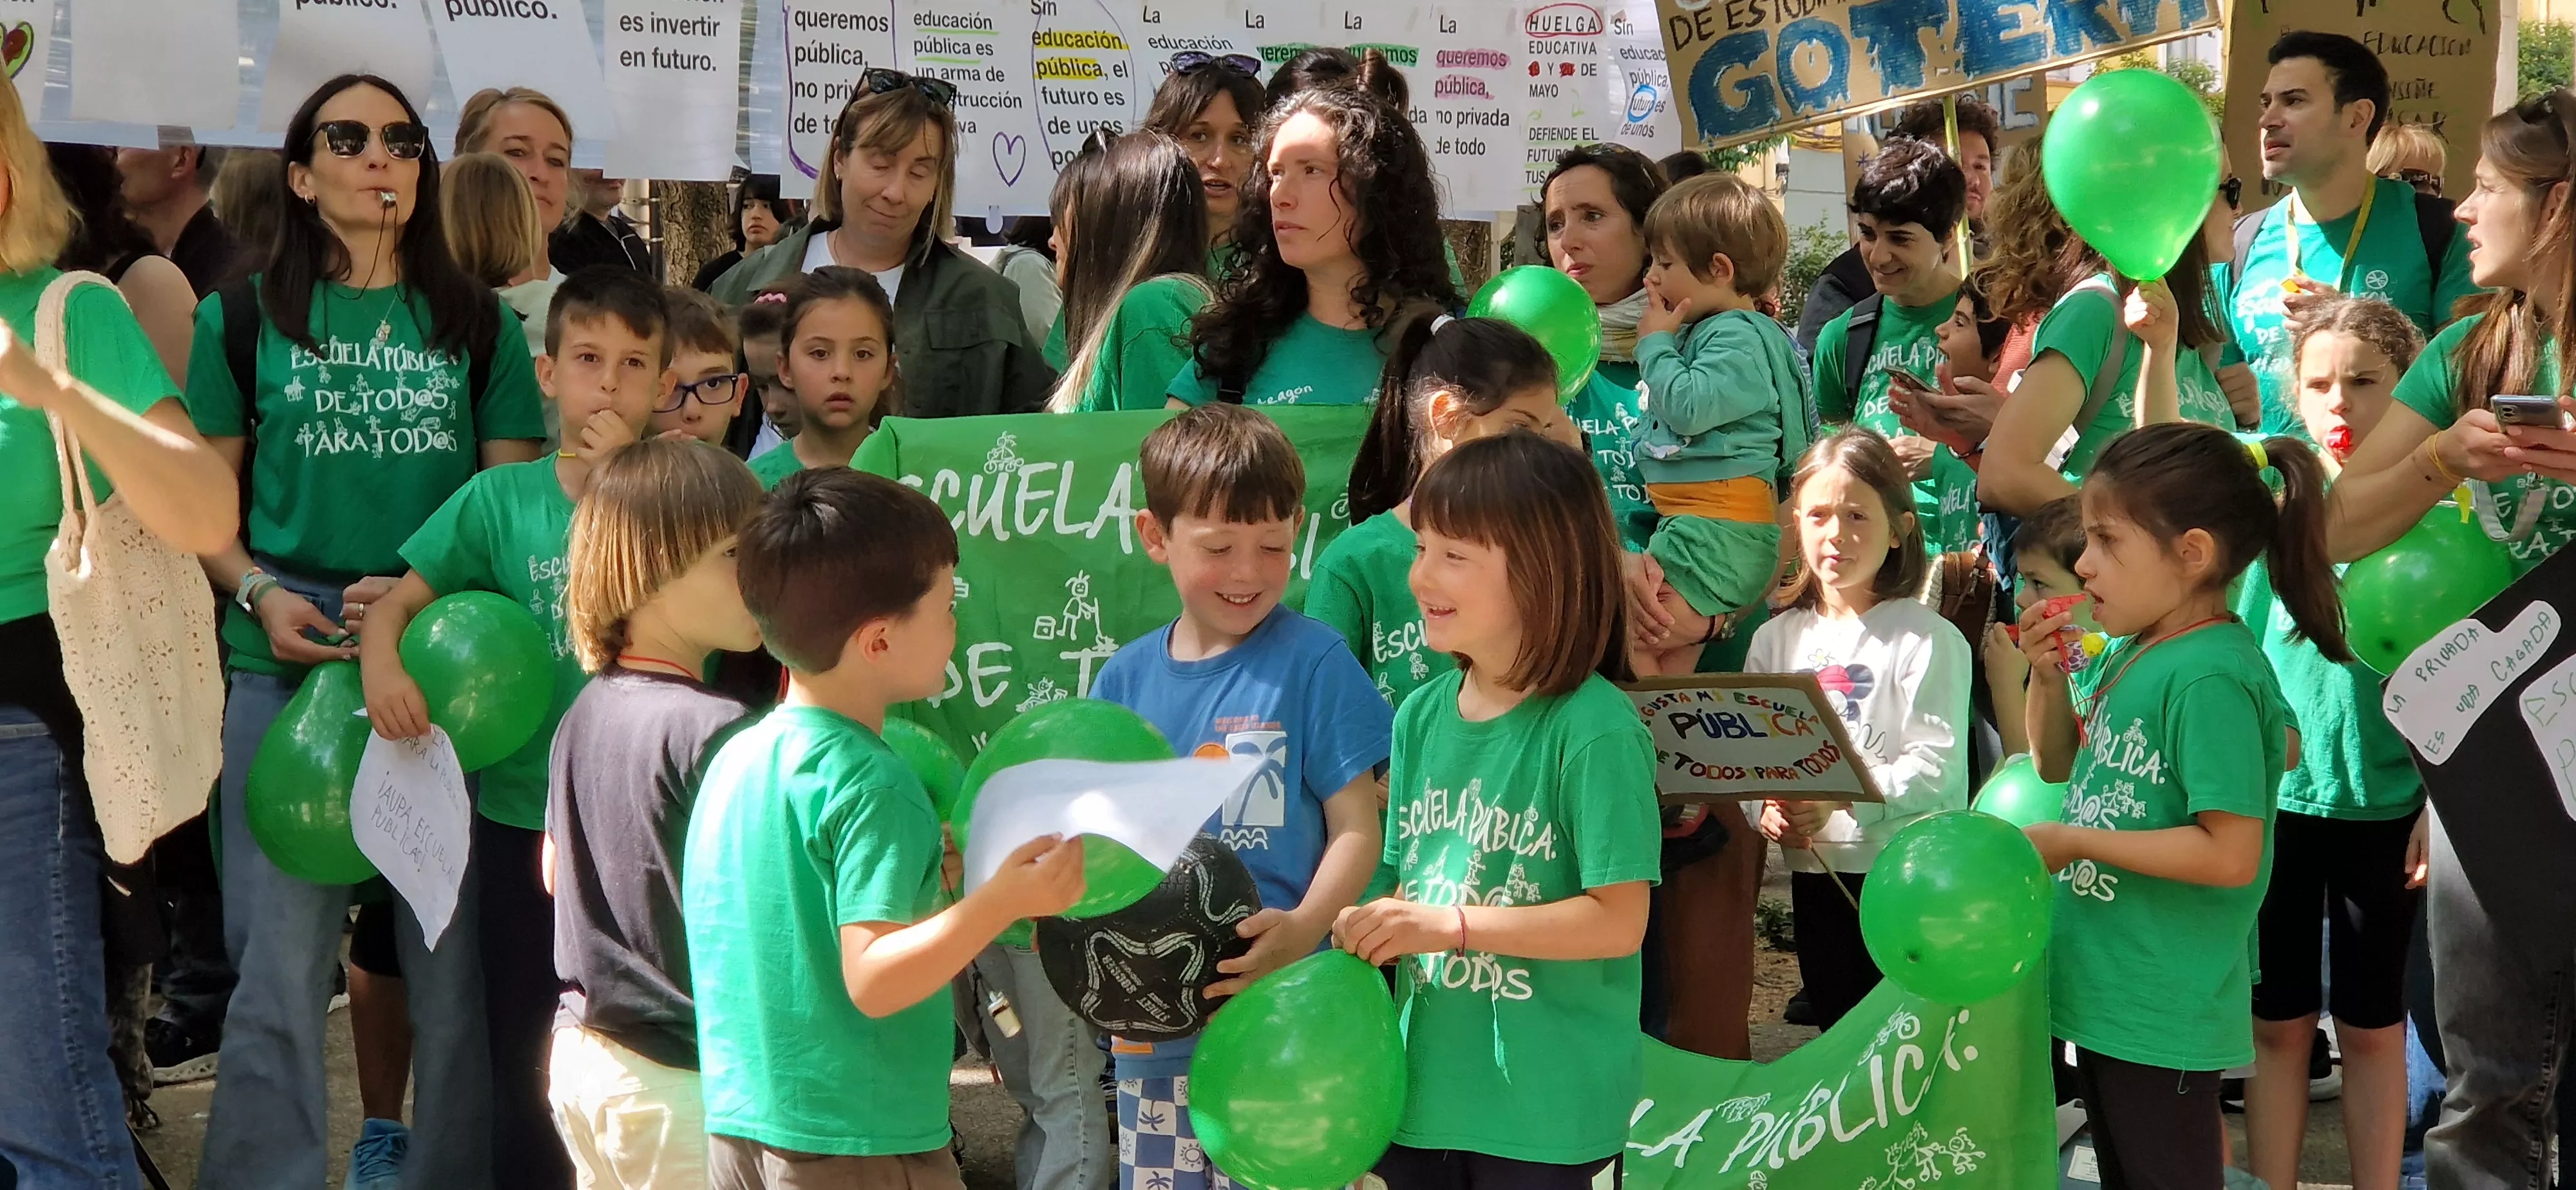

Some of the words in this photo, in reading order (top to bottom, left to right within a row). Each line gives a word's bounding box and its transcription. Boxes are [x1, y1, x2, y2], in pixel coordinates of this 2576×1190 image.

[620, 14, 644, 32] es
[651, 12, 721, 37] invertir
[795, 10, 889, 32] queremos
[913, 10, 992, 30] educación
[1142, 6, 1160, 24] La
[1245, 9, 1265, 29] La
[1344, 10, 1363, 30] La
[1439, 14, 1457, 33] La
[1529, 15, 1597, 32] HUELGA
[1614, 17, 1634, 36] Sin
[1669, 6, 1715, 52] DE
[914, 35, 971, 56] pública
[976, 42, 994, 56] es
[1032, 30, 1123, 50] educación
[1147, 35, 1233, 51] educación
[1529, 41, 1597, 55] EDUCATIVA
[620, 50, 645, 68] en
[652, 46, 717, 71] futuro.
[1036, 56, 1109, 81] pública,
[1112, 60, 1129, 78] el
[1436, 49, 1508, 68] queremos
[940, 67, 981, 81] arma
[985, 66, 1005, 82] de
[1547, 62, 1555, 76] Y
[1581, 63, 1597, 77] DE
[795, 81, 817, 98] no
[1041, 86, 1099, 106] futuro
[1103, 90, 1126, 106] es
[1434, 75, 1490, 100] pública,
[1529, 84, 1559, 97] MAYO
[1654, 100, 1667, 113] es
[795, 113, 817, 134] de
[1047, 116, 1071, 135] de
[1456, 108, 1510, 129] privada
[1529, 128, 1577, 141] DEFIENDE
[1582, 127, 1600, 140] EL
[1454, 137, 1486, 156] todo
[1525, 171, 1546, 184] TUS
[290, 342, 381, 371] ESCUELA
[314, 390, 353, 414] DE
[356, 388, 450, 414] TOD@S
[301, 429, 370, 458] PARA
[369, 428, 459, 455] TOD@S
[2423, 729, 2445, 755] ES
[2490, 610, 2552, 682] CAGADA
[1640, 692, 1692, 717] GUSTA
[1696, 690, 1725, 703] MI
[1733, 691, 1820, 725] ESCUELA
[2386, 694, 2407, 714] LA
[1668, 708, 1816, 740] PÚBLICA
[1674, 751, 1747, 781] TODOS
[1754, 766, 1801, 781] PARA
[1792, 739, 1842, 778] TODOS
